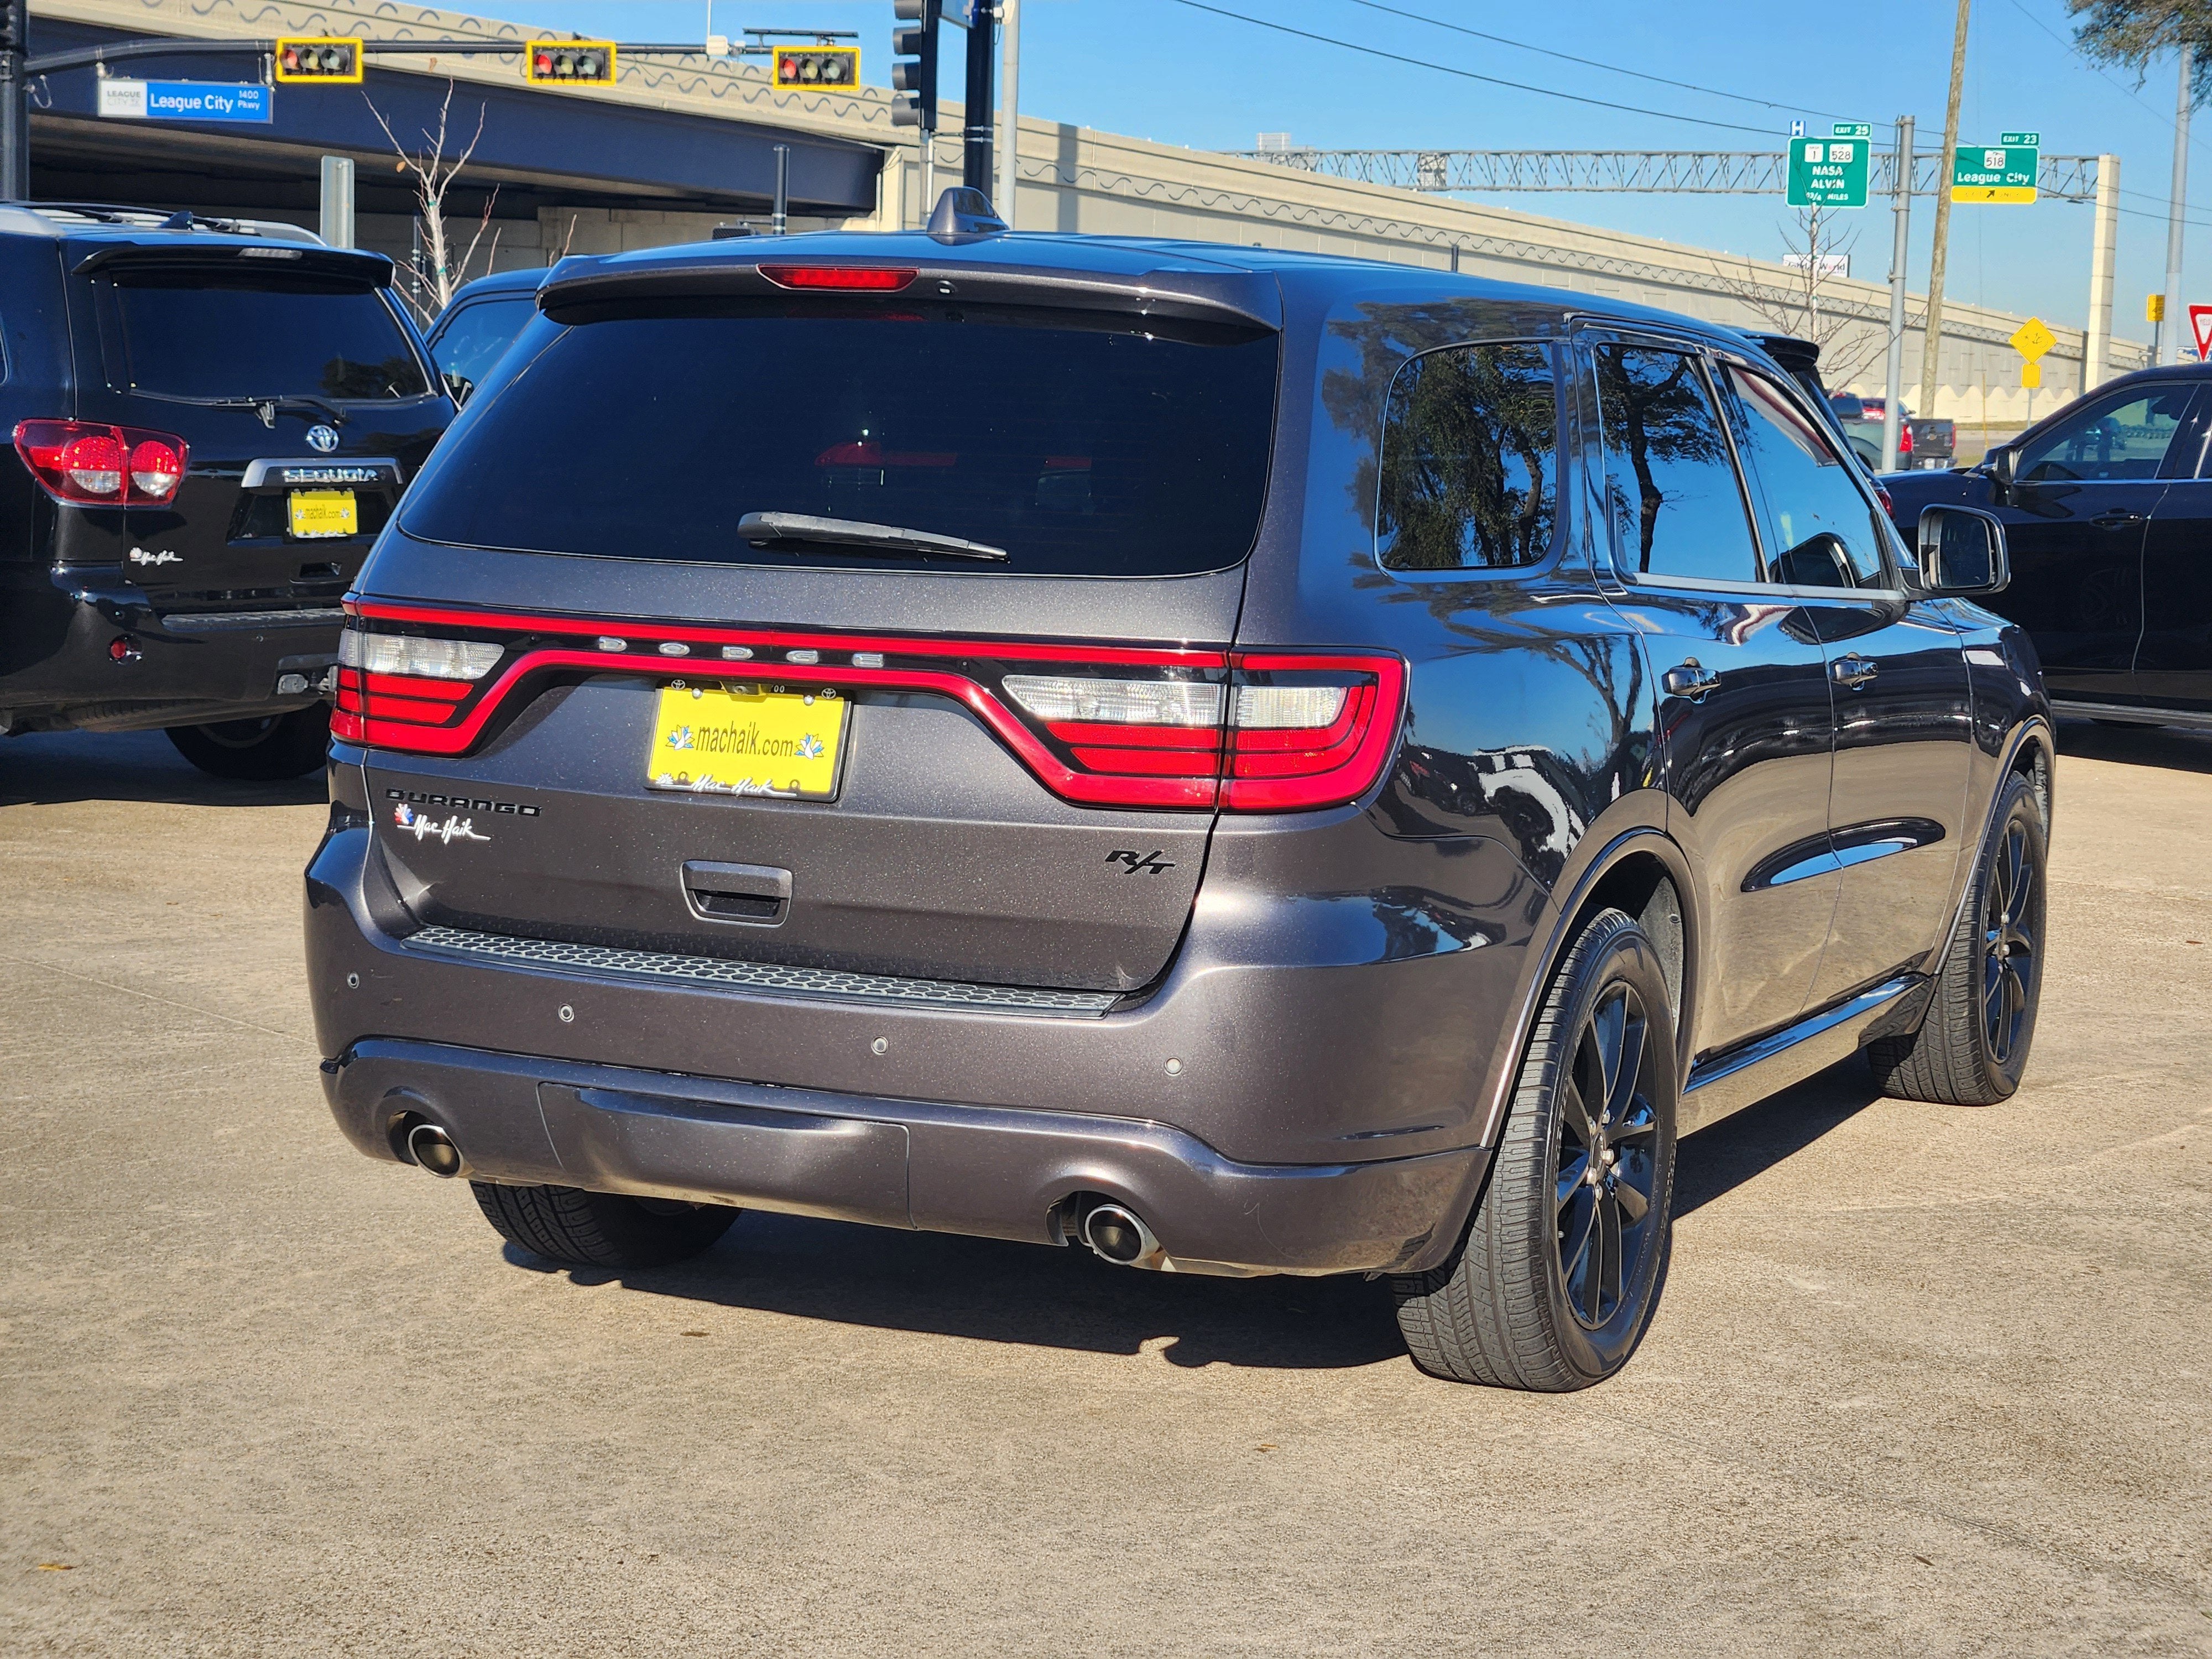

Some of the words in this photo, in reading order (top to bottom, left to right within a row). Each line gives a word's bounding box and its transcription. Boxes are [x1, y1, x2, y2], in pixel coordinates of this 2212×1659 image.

[238, 90, 259, 99] 1400
[150, 93, 202, 112] League
[204, 96, 234, 113] City
[237, 100, 260, 111] Pkwy
[1792, 121, 1804, 137] H
[1855, 126, 1869, 135] 25
[2023, 134, 2037, 144] 23
[1813, 150, 1816, 160] 1
[1832, 150, 1851, 160] 528
[1986, 157, 2004, 166] 518
[1812, 166, 1844, 176] NASA
[1811, 179, 1845, 189] ALVIN
[1957, 172, 2001, 184] League
[2006, 172, 2030, 185] City
[282, 468, 379, 483] SEQUOIA
[598, 635, 884, 668] DODGE
[696, 721, 793, 757] machaik.com
[690, 774, 731, 793] Mac
[386, 789, 542, 817] DURANGO
[414, 814, 442, 841] Mac
[441, 815, 492, 845] Haik
[1104, 850, 1176, 874] R/T
